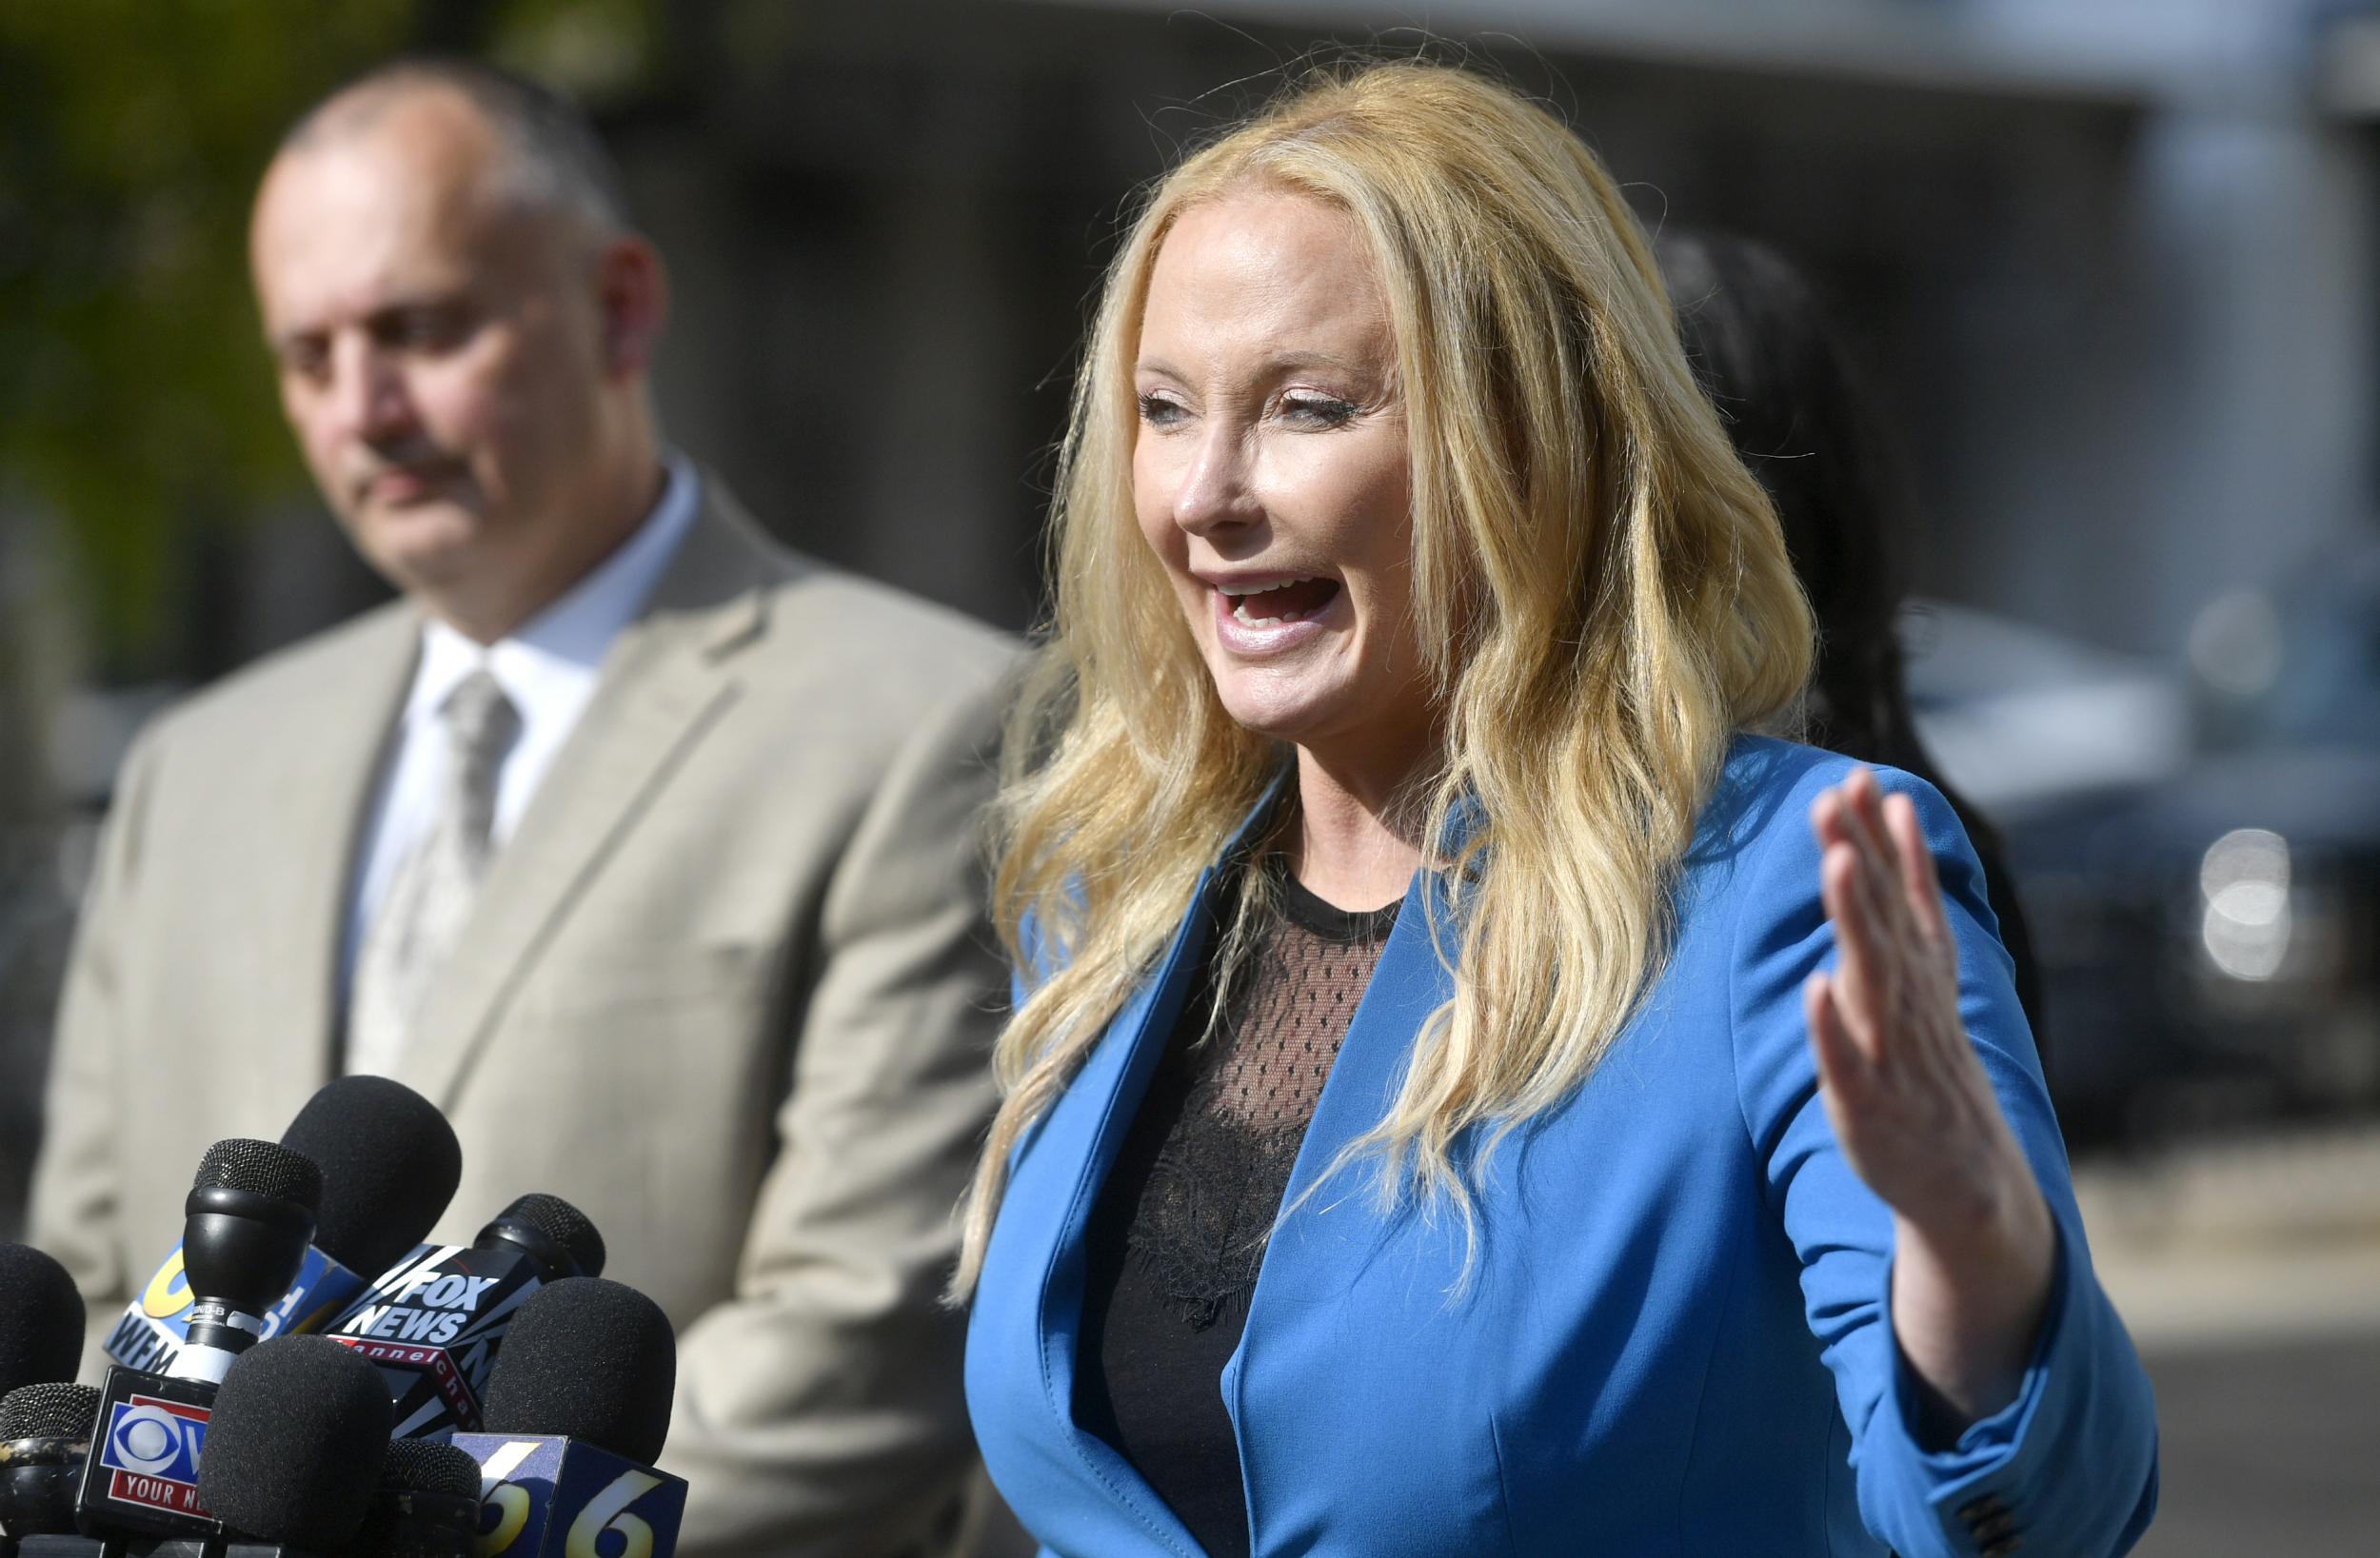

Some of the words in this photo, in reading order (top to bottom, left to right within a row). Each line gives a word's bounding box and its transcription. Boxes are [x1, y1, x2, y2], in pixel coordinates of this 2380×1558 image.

[393, 1271, 500, 1311] FOX
[342, 1305, 466, 1343] NEWS
[339, 1339, 440, 1365] annel
[436, 1359, 479, 1430] cha
[126, 1475, 174, 1505] YOUR
[184, 1489, 200, 1511] N
[565, 1469, 664, 1558] 6
